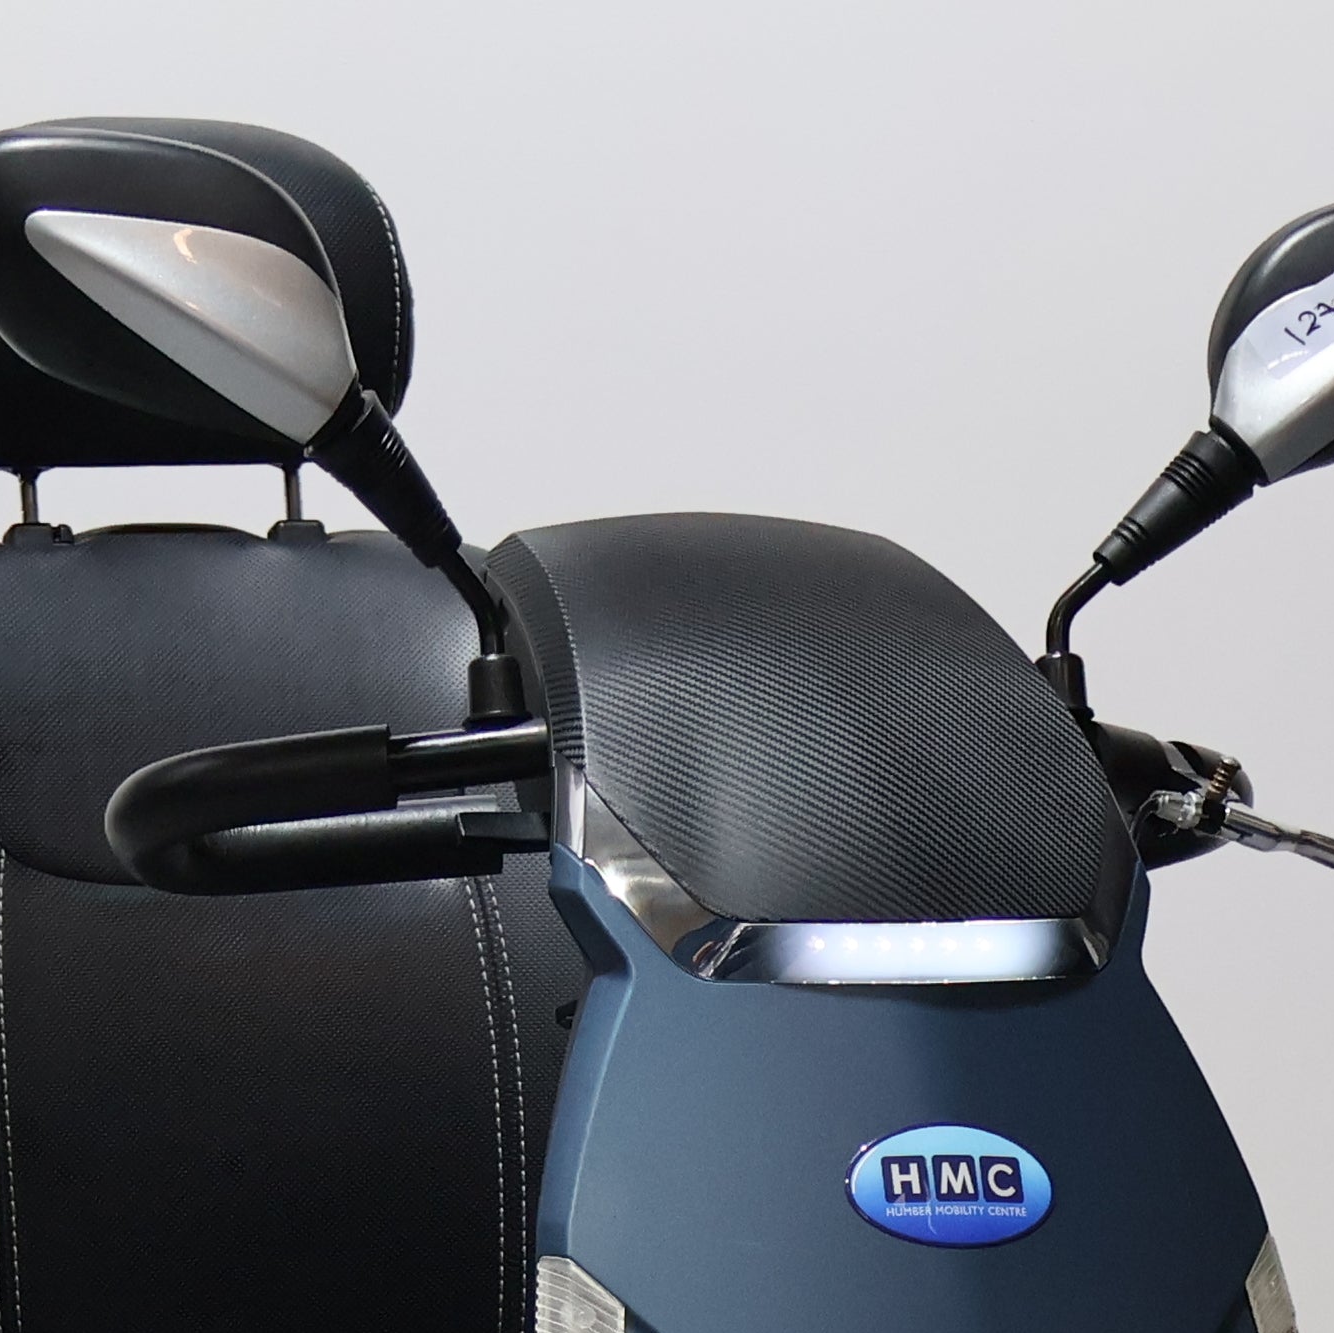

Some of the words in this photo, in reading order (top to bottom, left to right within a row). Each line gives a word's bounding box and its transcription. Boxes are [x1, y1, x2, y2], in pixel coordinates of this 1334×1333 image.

[886, 1206, 932, 1217] HUMBER
[936, 1205, 985, 1216] MOBILITY
[988, 1206, 1027, 1217] CENTRE
